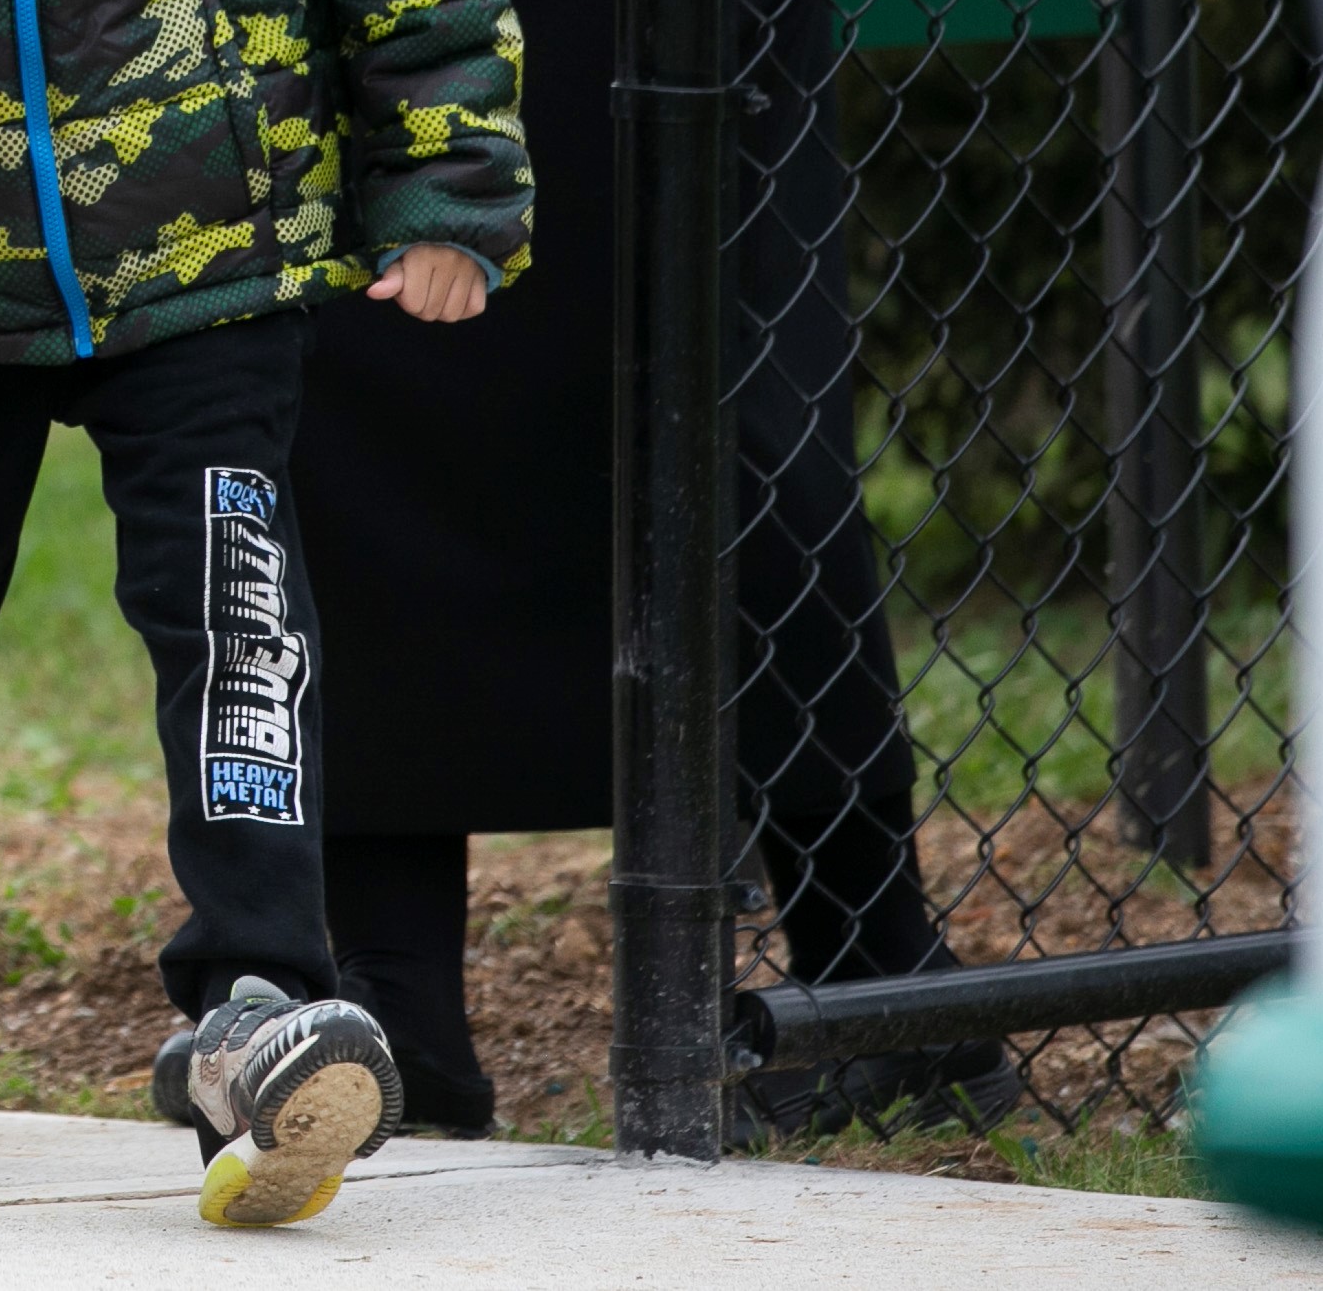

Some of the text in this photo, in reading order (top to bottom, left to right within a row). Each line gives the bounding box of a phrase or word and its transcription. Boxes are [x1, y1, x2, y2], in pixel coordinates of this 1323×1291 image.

[218, 638, 299, 761] BLUE
[212, 761, 294, 791] HEAVY
[212, 781, 289, 810] METAL
